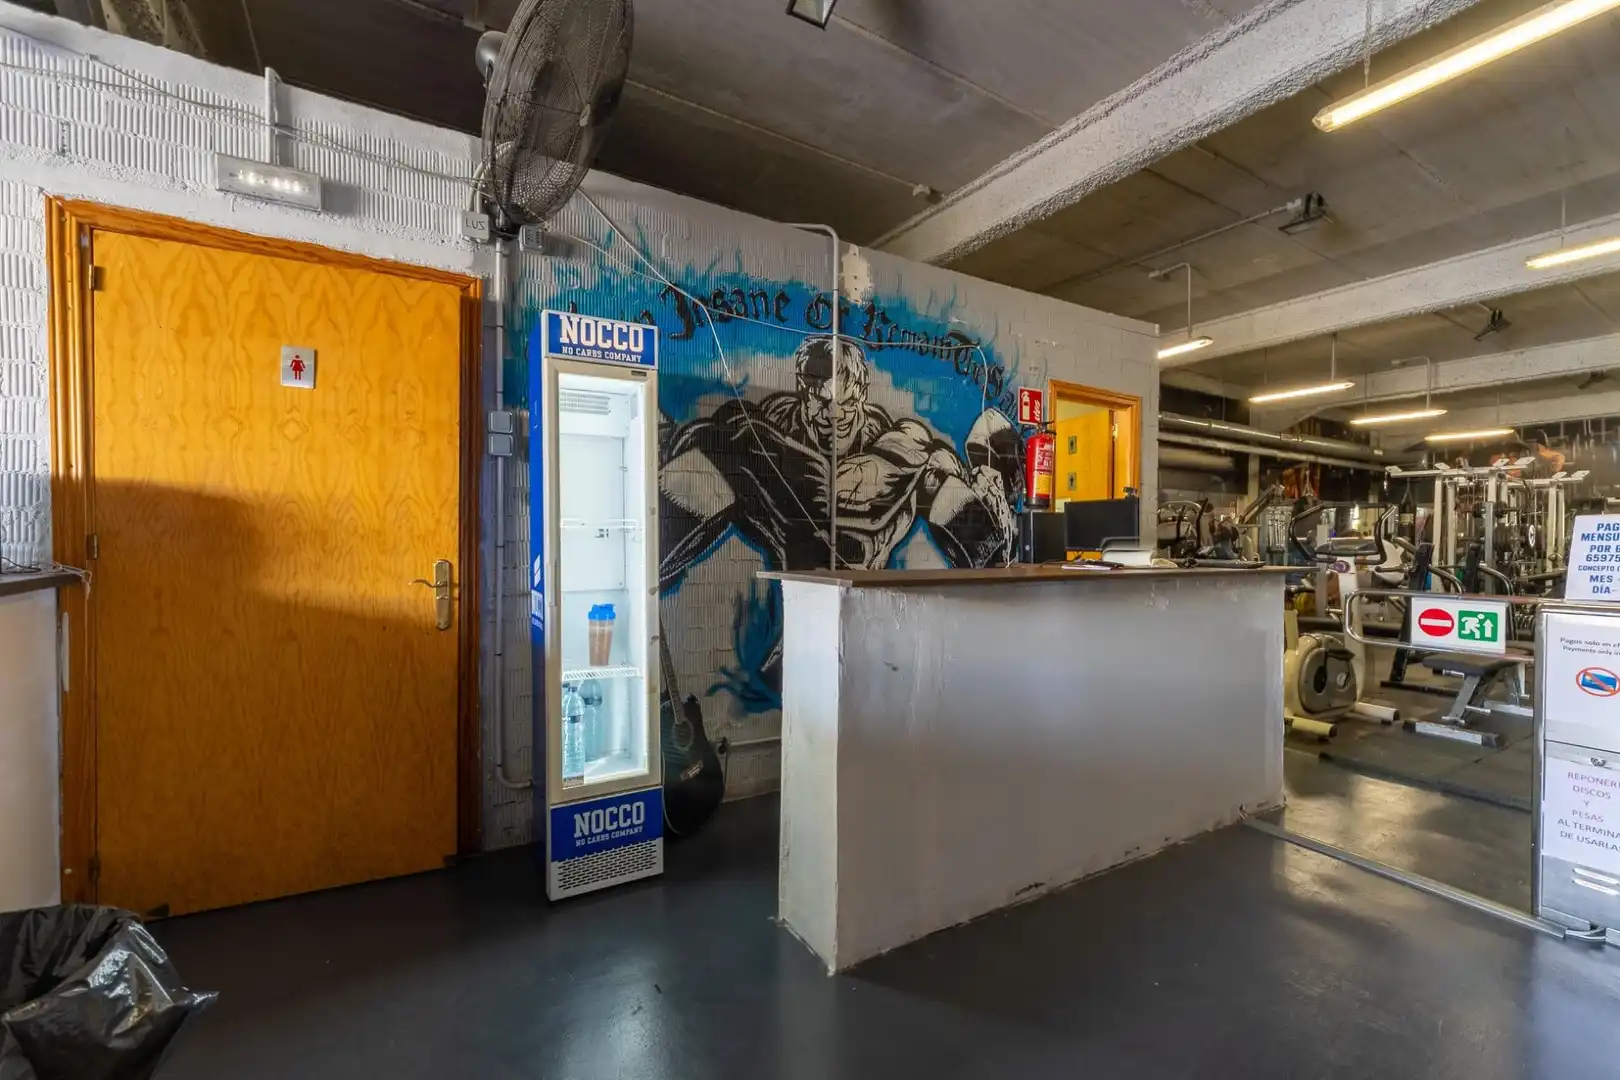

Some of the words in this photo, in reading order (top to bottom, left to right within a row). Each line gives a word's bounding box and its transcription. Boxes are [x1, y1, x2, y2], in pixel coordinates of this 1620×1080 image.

[559, 315, 644, 353] NOCCO
[561, 346, 574, 356] NO
[575, 347, 602, 359] CARBS
[604, 351, 642, 363] COMPANY
[1596, 523, 1620, 532] PAG
[1580, 532, 1620, 542] MENSU
[1589, 544, 1612, 553] POR
[1585, 553, 1620, 563] 65975
[1578, 564, 1615, 572] CONCEPTO
[1589, 574, 1614, 583] MES
[1560, 637, 1583, 646] Pagos
[1563, 645, 1597, 654] Payments
[1572, 785, 1611, 799] DISCOS
[573, 801, 645, 838] NOCCO
[1572, 809, 1604, 823] PESAS
[1557, 818, 1570, 827] AL
[1573, 821, 1620, 838] TERMINA
[575, 838, 586, 847] NO
[611, 826, 643, 839] COMPANY
[1560, 830, 1573, 839] DE
[1577, 834, 1620, 852] USARLA
